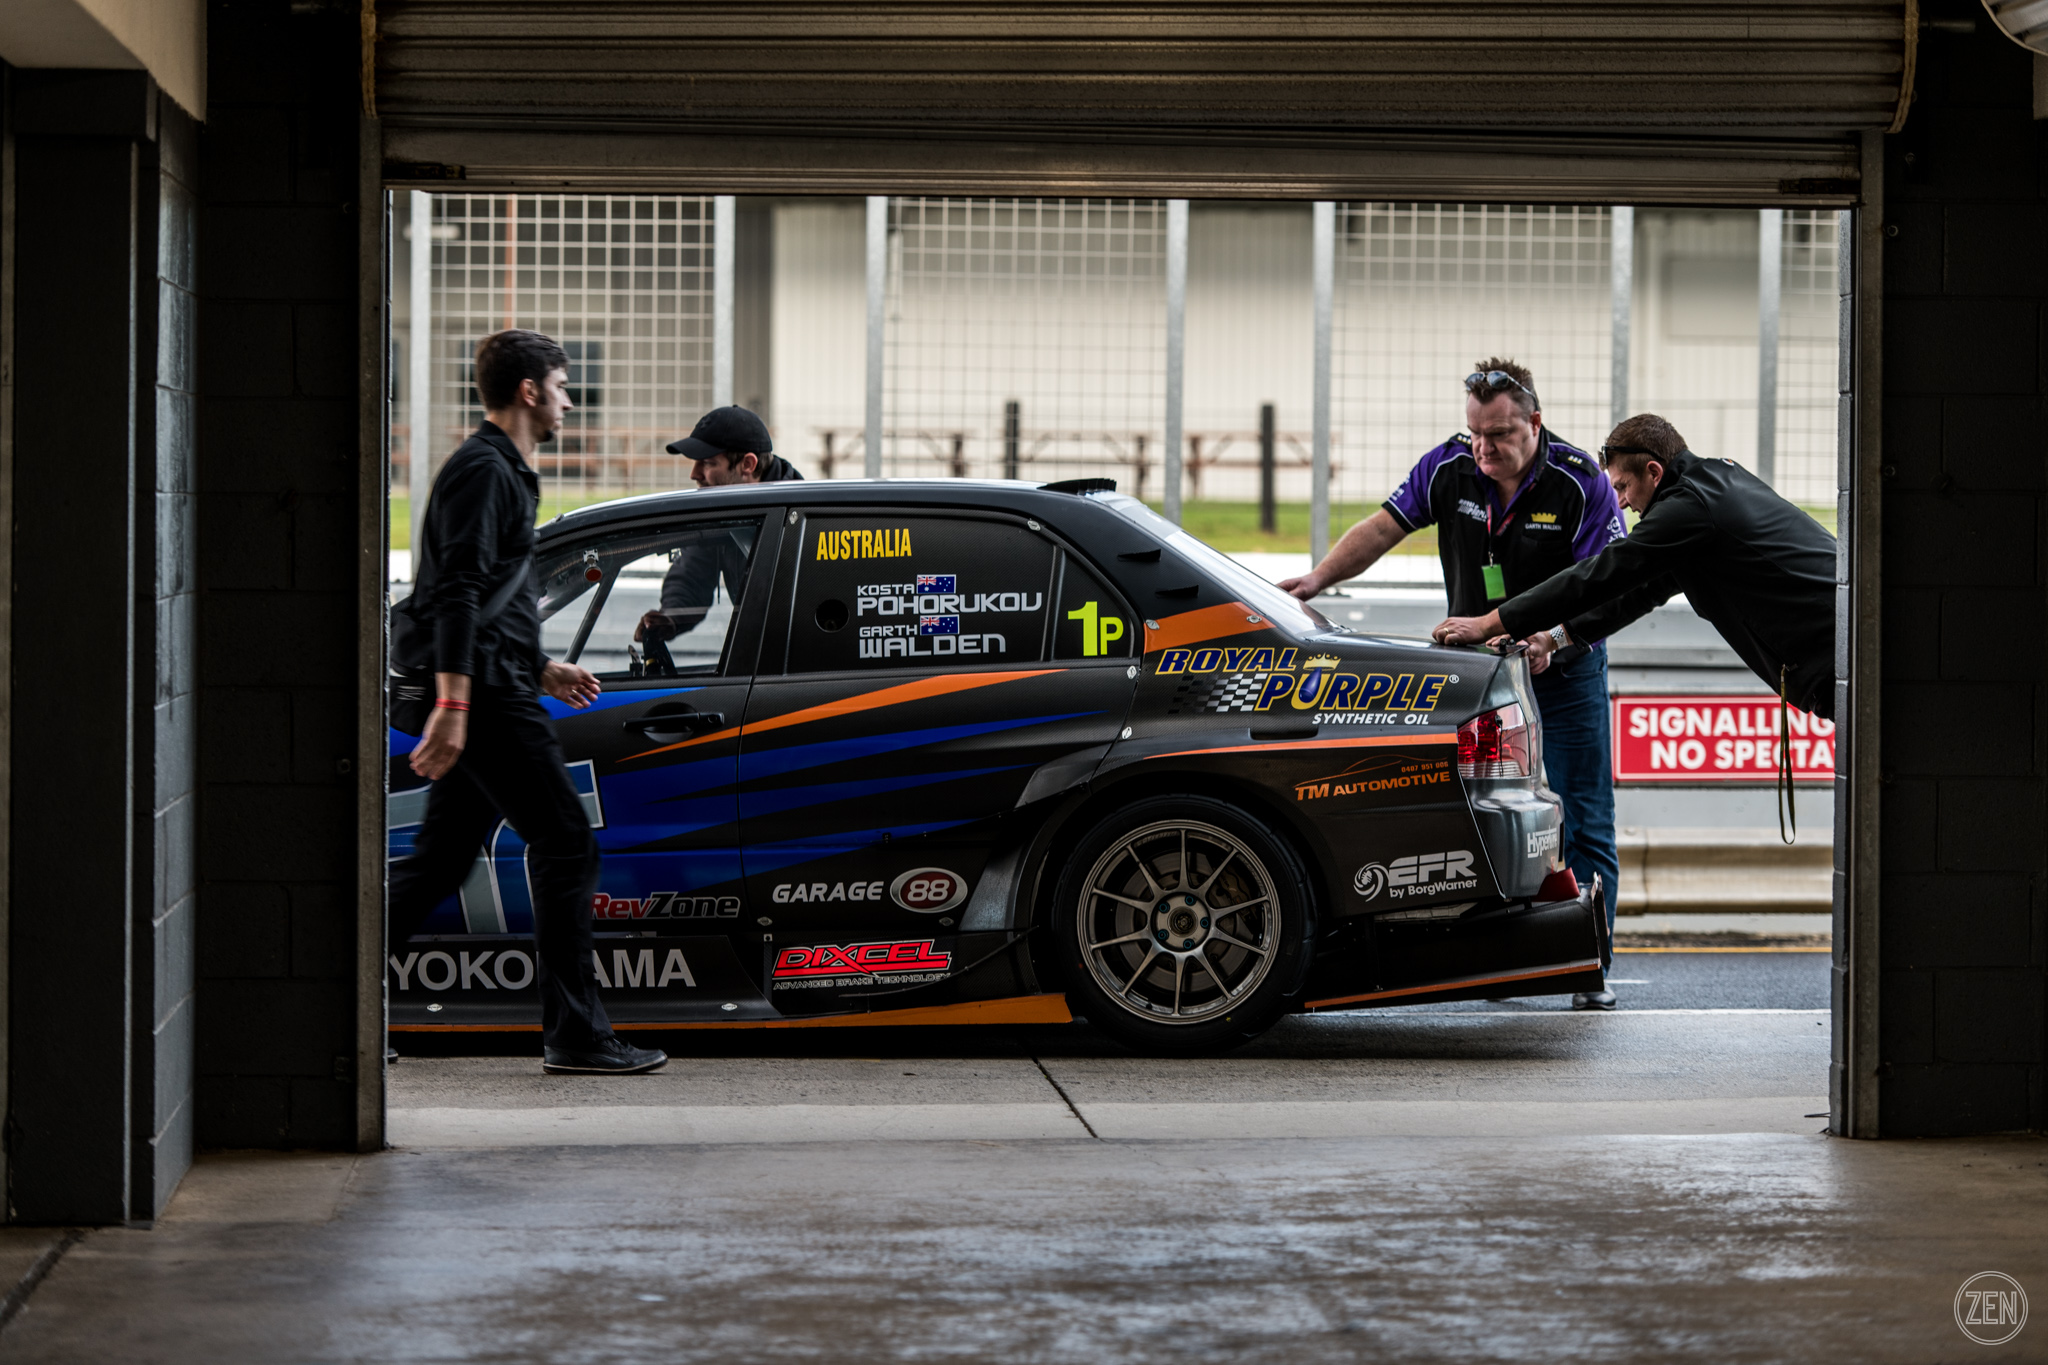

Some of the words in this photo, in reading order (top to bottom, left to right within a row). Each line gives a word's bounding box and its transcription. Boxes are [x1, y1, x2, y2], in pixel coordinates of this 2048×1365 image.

[816, 528, 912, 561] AUSTRALIA
[857, 583, 915, 596] KOSTA
[857, 592, 1042, 616] POHORUKOV
[859, 624, 918, 637] GARTH
[859, 633, 1006, 659] WALDEN
[1155, 648, 1298, 675] ROYAL
[1254, 672, 1449, 711] PURPLE
[1312, 713, 1398, 725] SYNTHETIC
[1404, 713, 1429, 725] OIL
[1628, 707, 1835, 737] SIGNALLING
[1650, 739, 1706, 769] NO
[1714, 739, 1835, 769] SPECTA
[1295, 783, 1330, 800] TM
[1333, 771, 1450, 796] AUTOMOTIVE
[1388, 849, 1477, 887] EFR
[772, 881, 884, 903] GARAGE
[907, 879, 950, 902] 88
[1389, 888, 1405, 899] by
[1408, 879, 1477, 896] BorgWarner
[591, 891, 741, 920] RevZone
[388, 949, 697, 990] YOKOAMA
[773, 939, 951, 976] DIXCEL
[773, 979, 834, 990] ADVANCED
[836, 977, 873, 987] BRAKE
[875, 973, 951, 985] TECHNOLOGY
